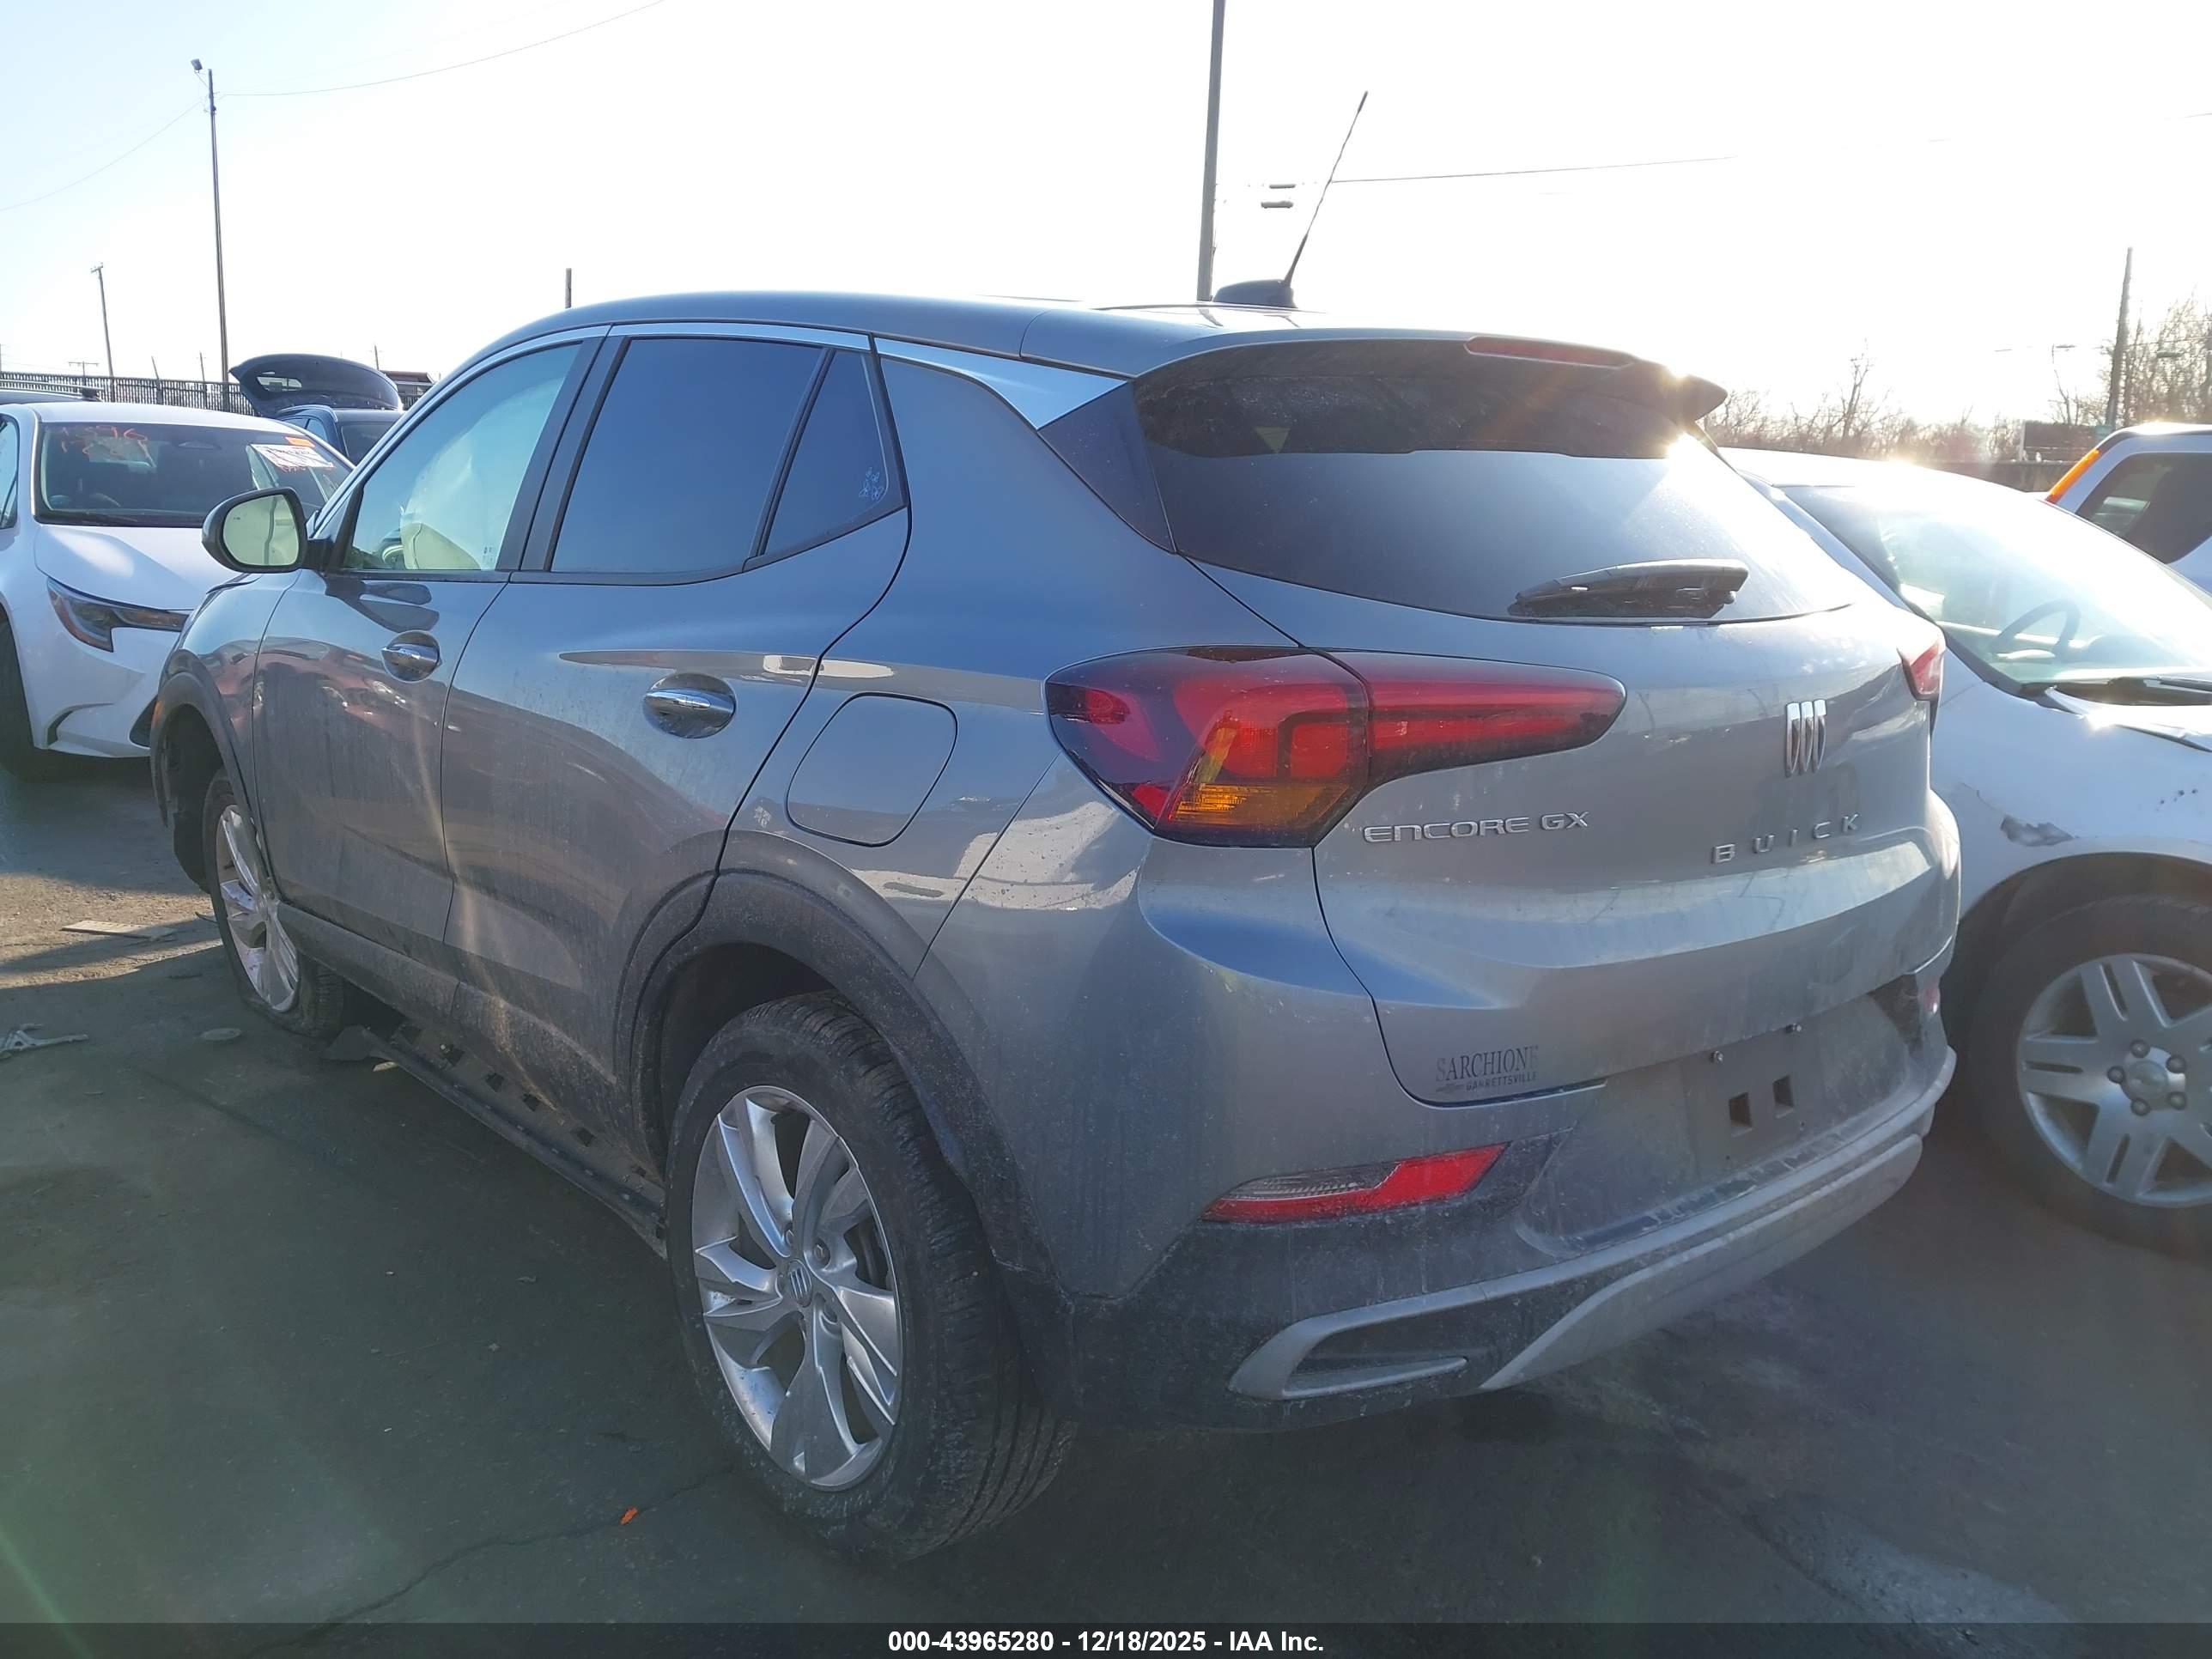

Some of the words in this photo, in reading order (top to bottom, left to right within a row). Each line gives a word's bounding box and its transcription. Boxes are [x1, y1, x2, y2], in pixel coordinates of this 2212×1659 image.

[1364, 817, 1530, 843] ENCORE
[1541, 811, 1589, 831] GX
[1711, 813, 1859, 864] BUICK
